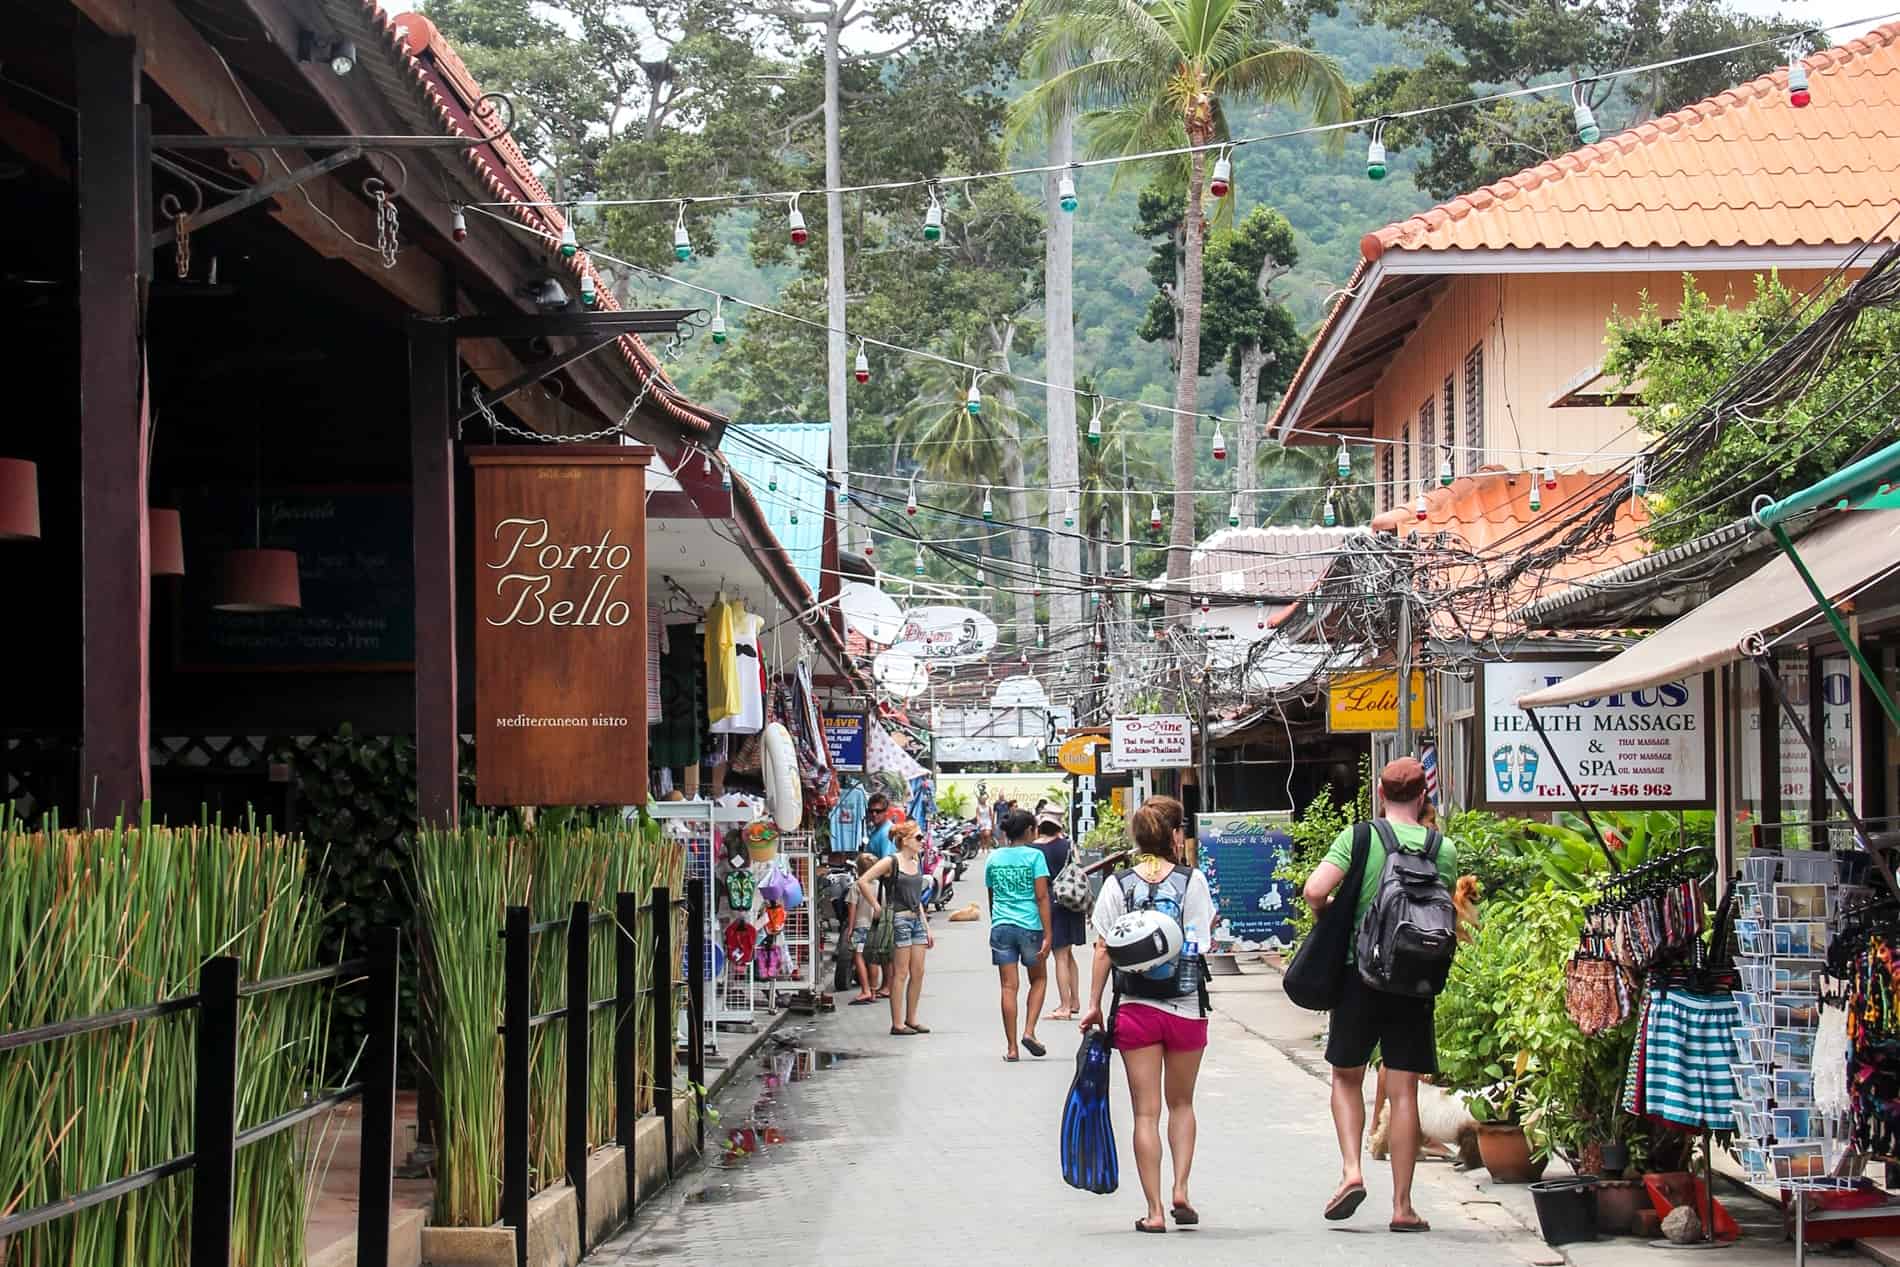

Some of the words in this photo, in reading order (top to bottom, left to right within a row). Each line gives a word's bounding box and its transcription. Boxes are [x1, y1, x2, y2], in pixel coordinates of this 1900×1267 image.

[486, 517, 631, 570] Porto
[486, 573, 631, 627] Bello
[1343, 687, 1400, 711] Lolit
[496, 713, 588, 727] Mediterranean
[591, 713, 628, 727] Bistro
[1493, 715, 1581, 732] HEALTH
[1593, 714, 1697, 732] MASSAGE
[1588, 739, 1605, 754] &
[1618, 738, 1635, 747] THAI
[1637, 738, 1671, 747] MASSAGE
[1618, 753, 1637, 761] FOOT
[1639, 753, 1673, 761] MASSAGE
[1578, 760, 1618, 777] SPA
[1617, 767, 1631, 775] OIL
[1632, 767, 1665, 775] MASSAGE
[1536, 784, 1566, 797] Tel.
[1643, 784, 1673, 797] 962
